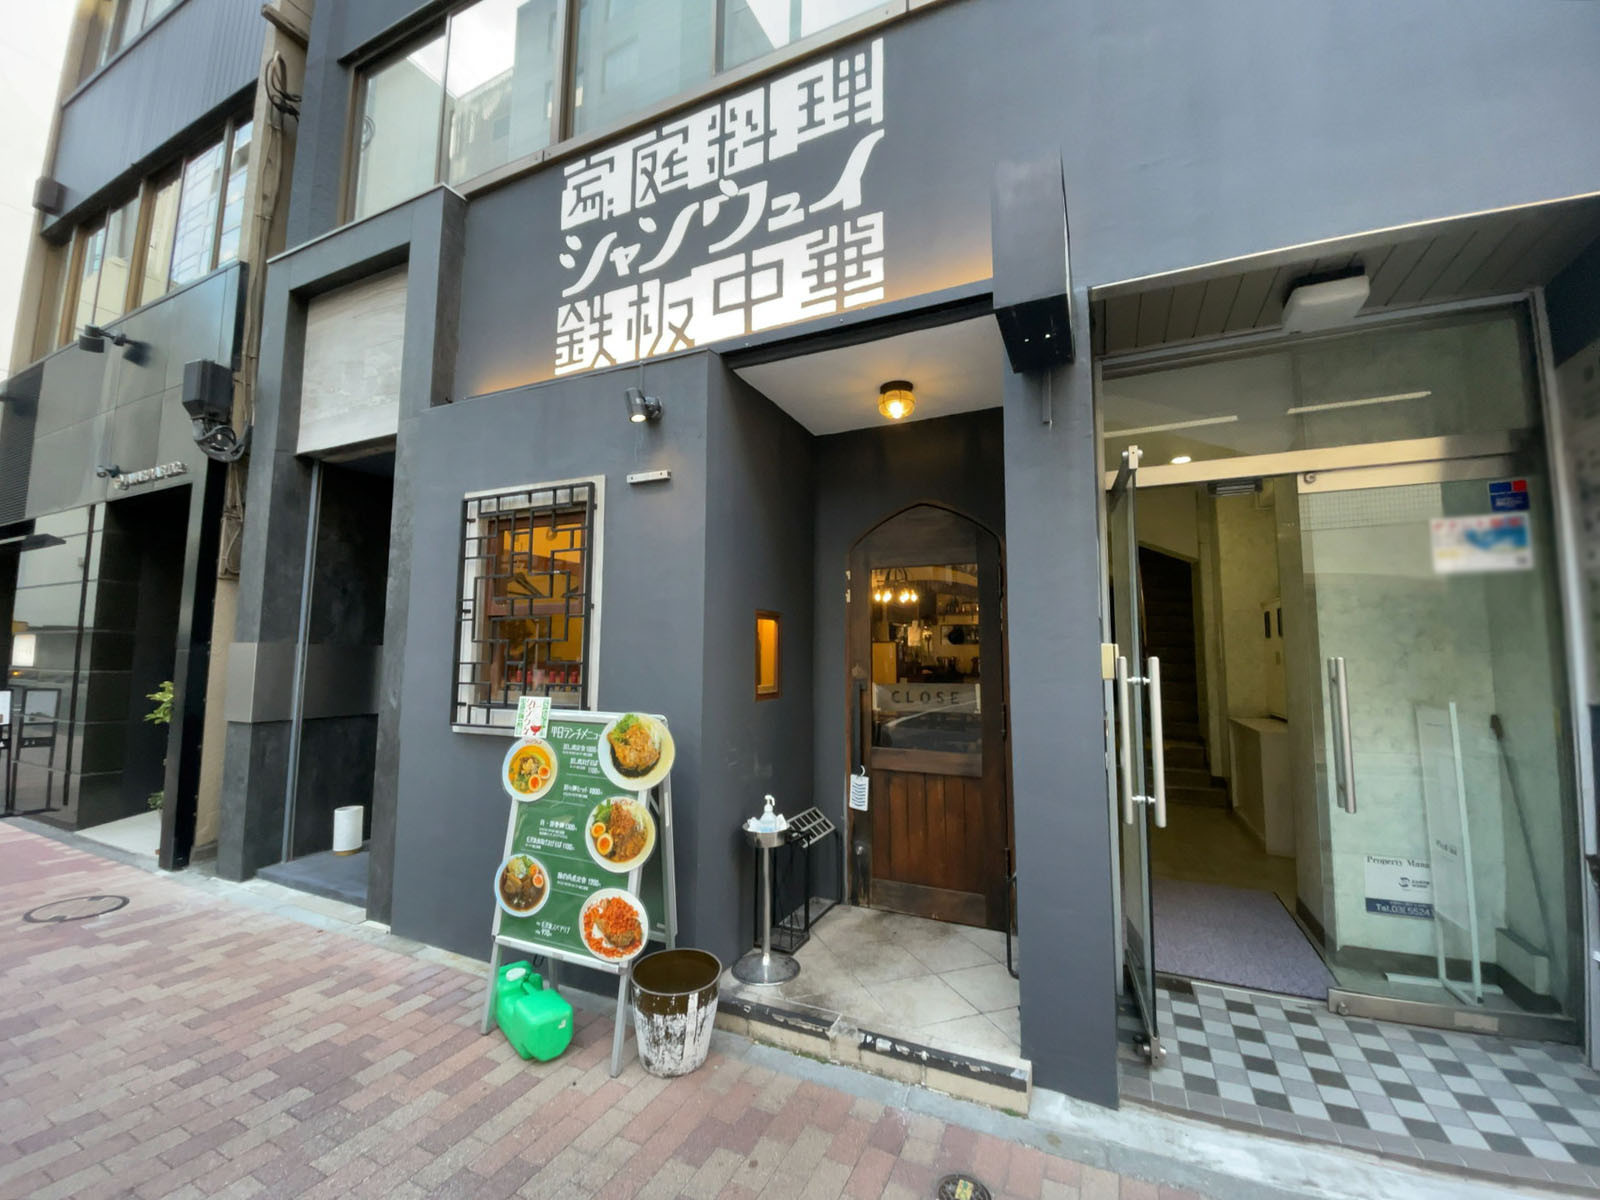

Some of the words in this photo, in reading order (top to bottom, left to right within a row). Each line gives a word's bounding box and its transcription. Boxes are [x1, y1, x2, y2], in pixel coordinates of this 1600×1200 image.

[554, 211, 884, 376] 鉄板中華
[891, 690, 960, 705] CLOSE
[1367, 855, 1403, 867] Property
